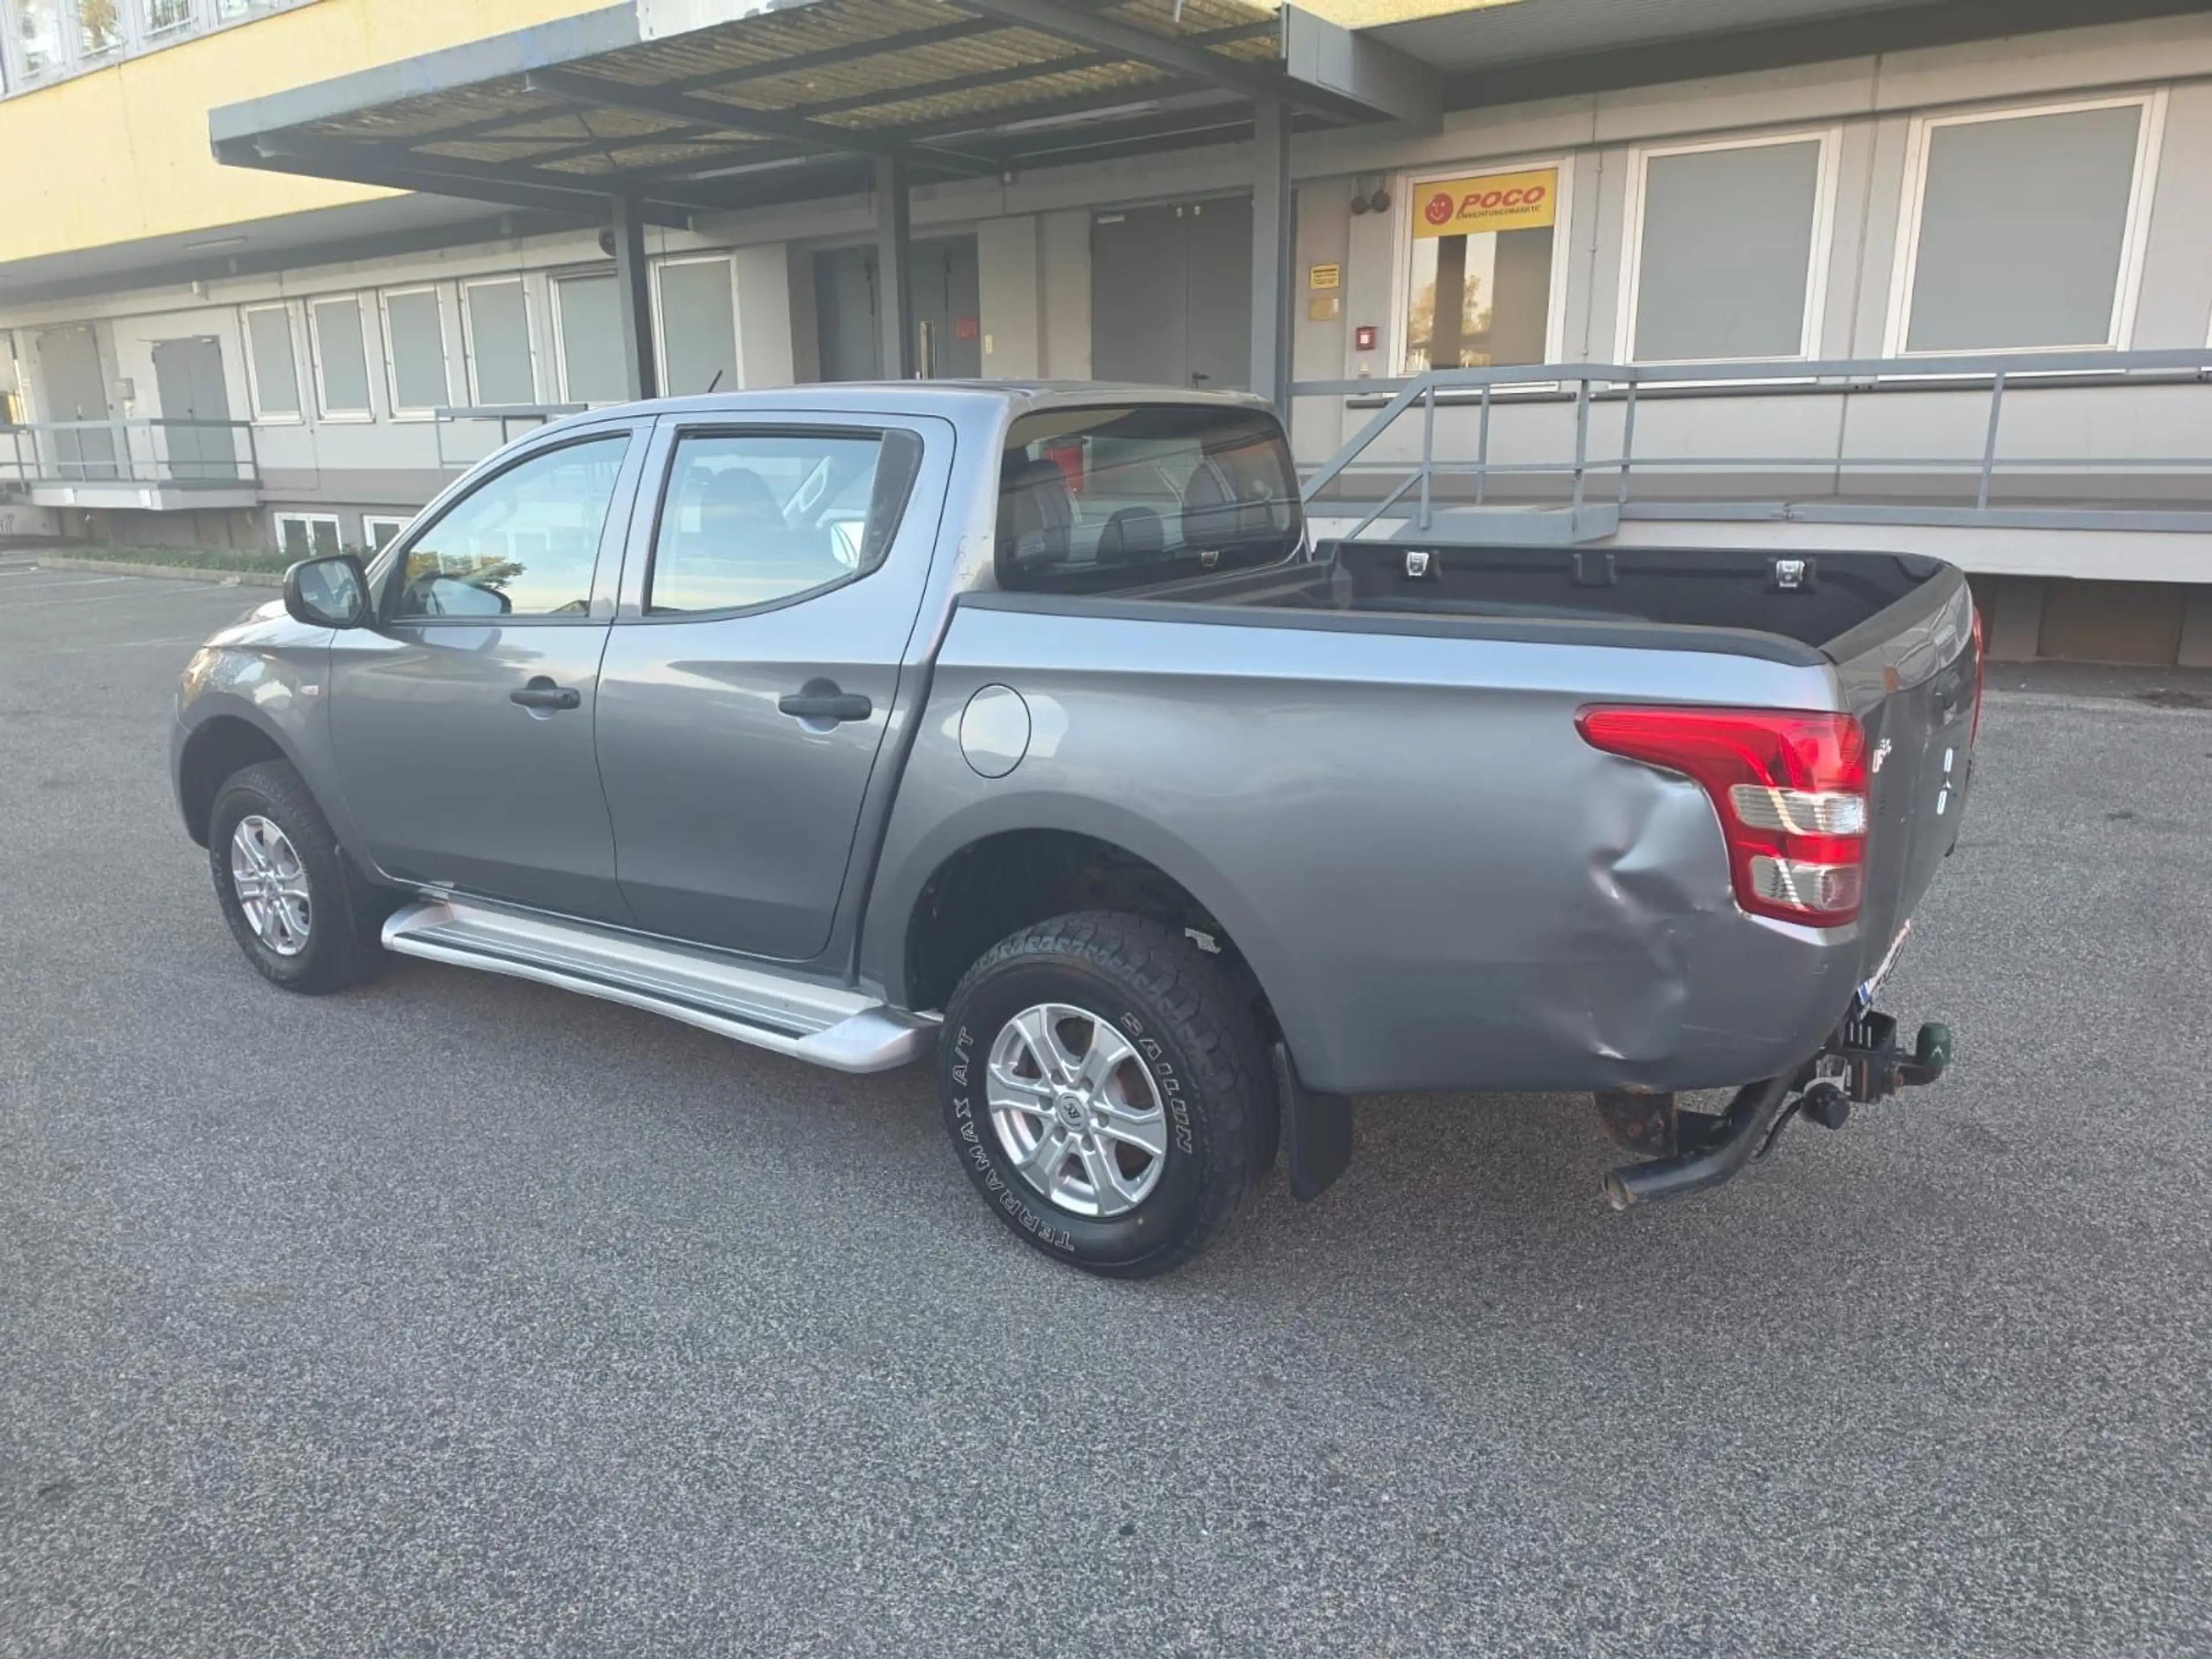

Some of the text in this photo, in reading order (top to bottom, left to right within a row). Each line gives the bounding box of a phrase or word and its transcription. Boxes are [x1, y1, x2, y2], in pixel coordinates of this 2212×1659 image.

[1458, 187, 1546, 217] POCO
[953, 1027, 1074, 1251] TERRAMAX A/T
[1121, 1013, 1192, 1153] SAILUN
